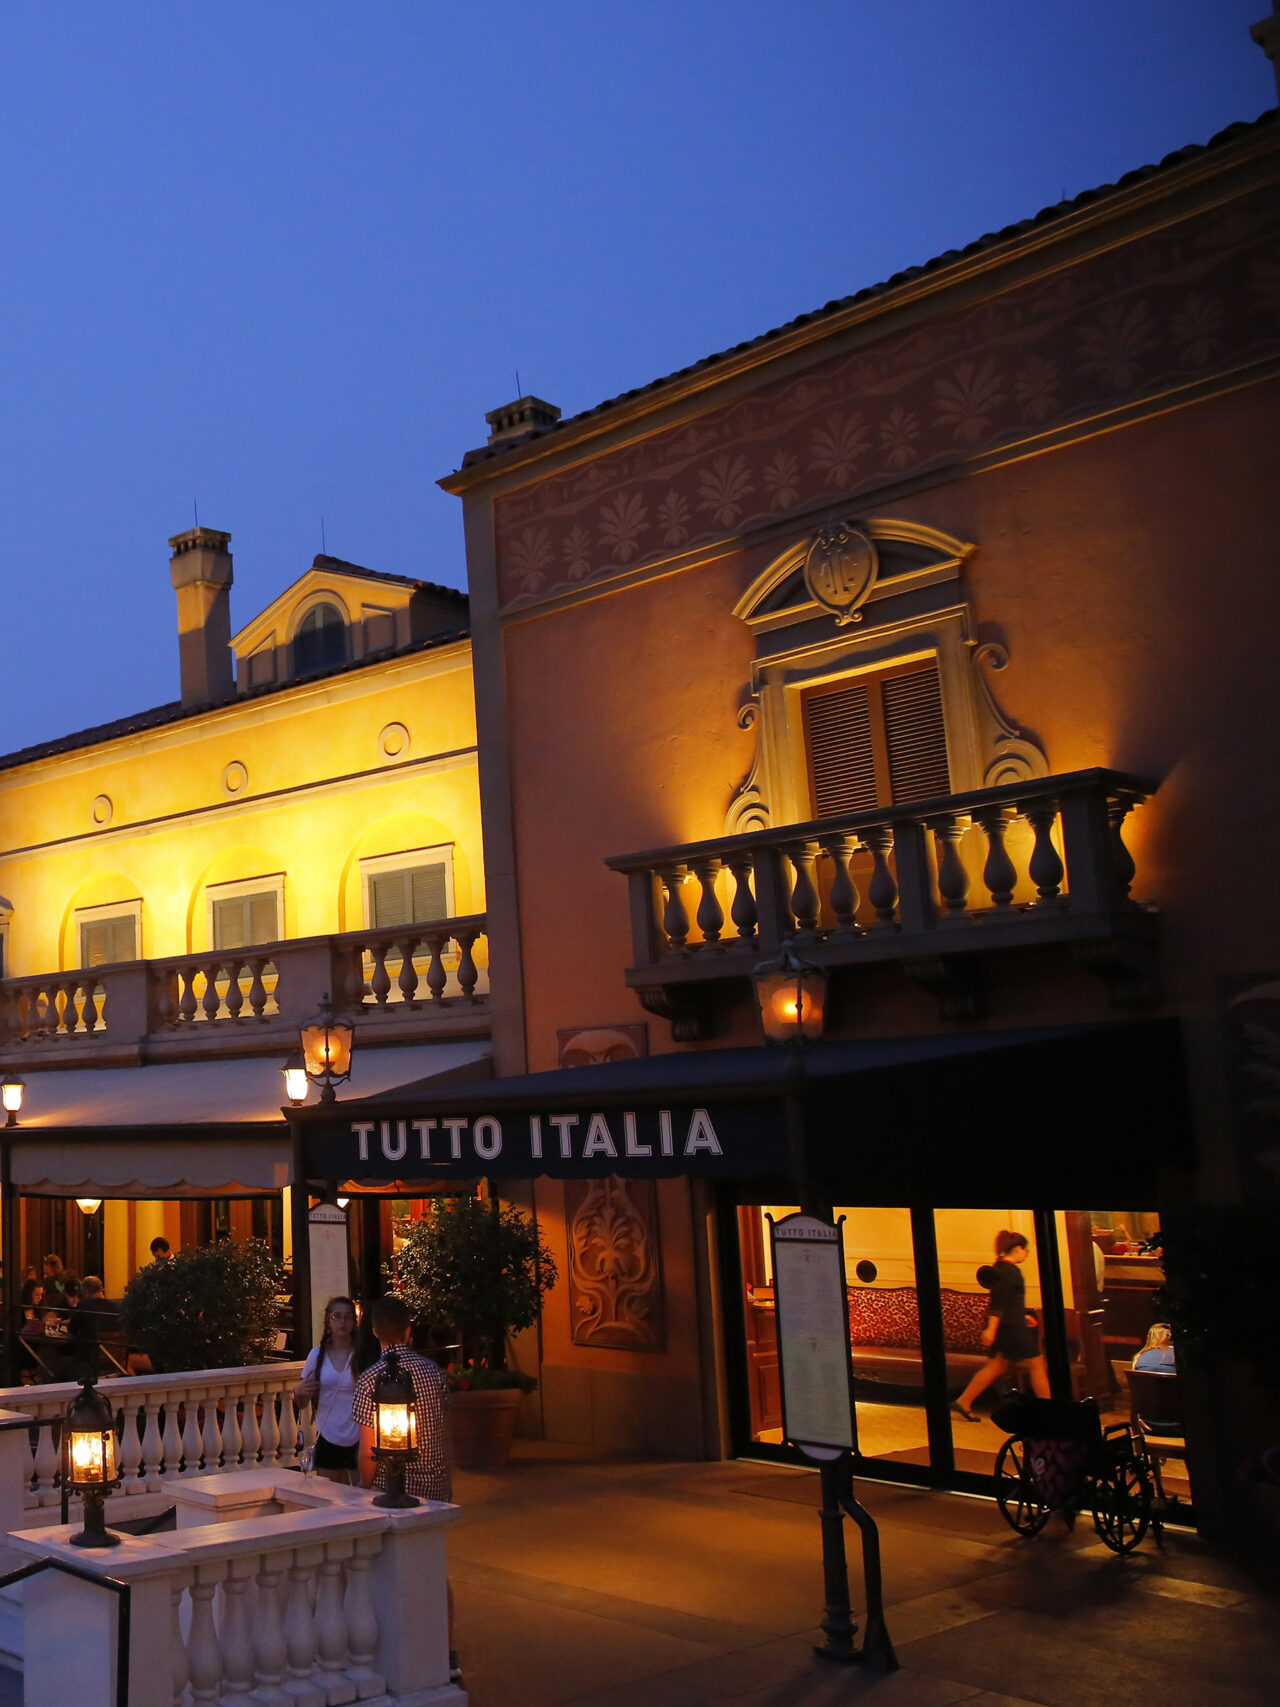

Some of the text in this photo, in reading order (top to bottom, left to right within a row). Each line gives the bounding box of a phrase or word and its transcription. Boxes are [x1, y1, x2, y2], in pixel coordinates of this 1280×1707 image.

[350, 1107, 724, 1161] TUTTO ITALIA
[775, 1227, 838, 1238] TUTTO ITALIA
